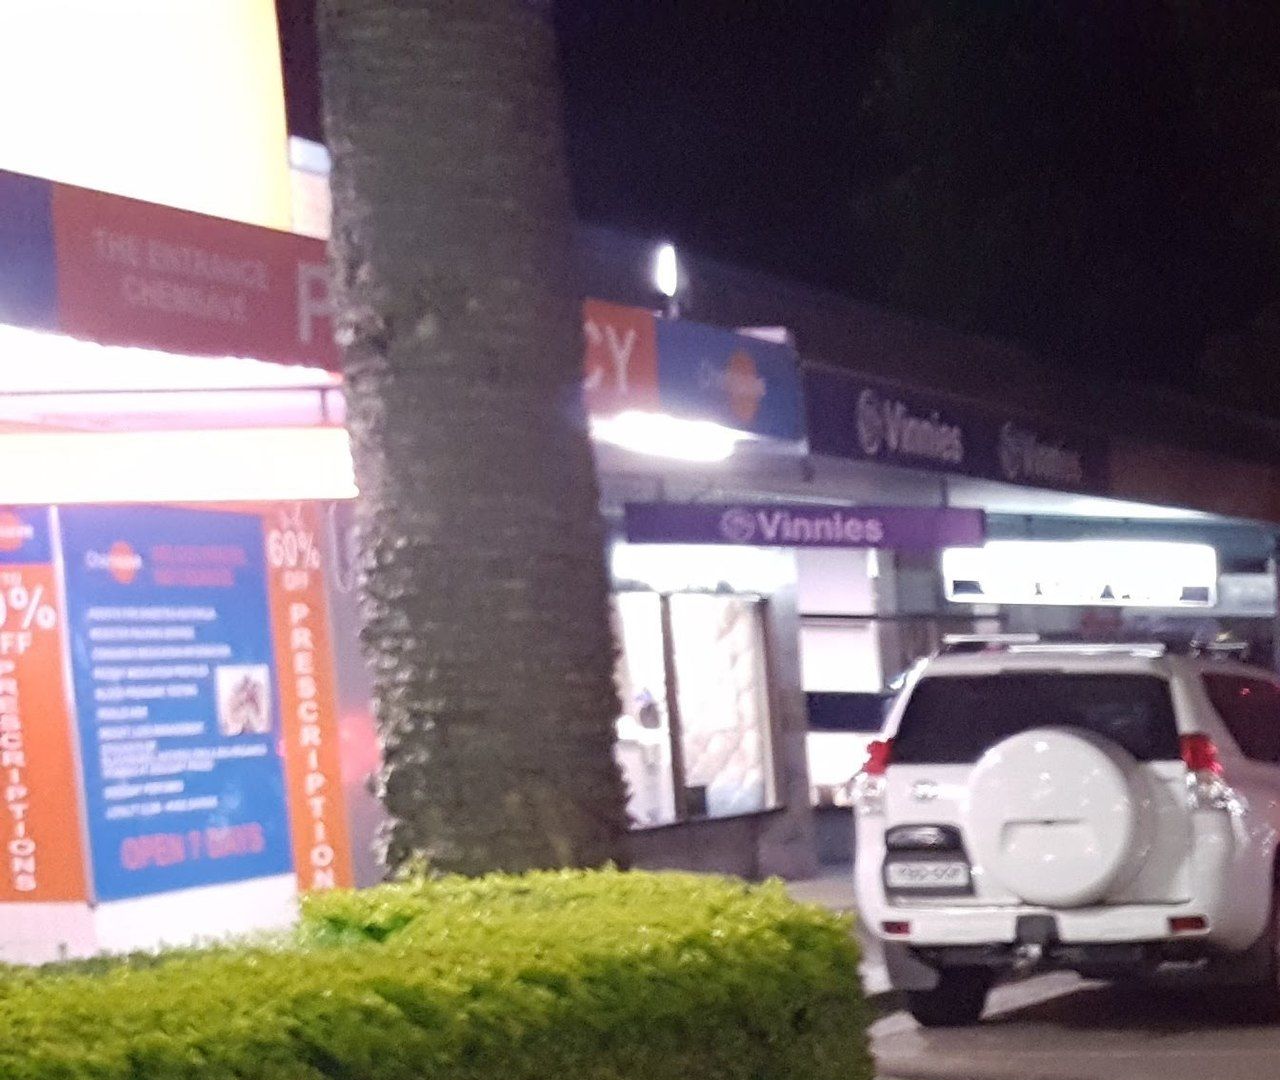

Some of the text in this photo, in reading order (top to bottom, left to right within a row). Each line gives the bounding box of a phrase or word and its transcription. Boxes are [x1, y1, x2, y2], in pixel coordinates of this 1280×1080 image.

[92, 227, 269, 292] THE ENTRANCE
[881, 400, 963, 465] Vinnies
[756, 510, 885, 543] Vinnies
